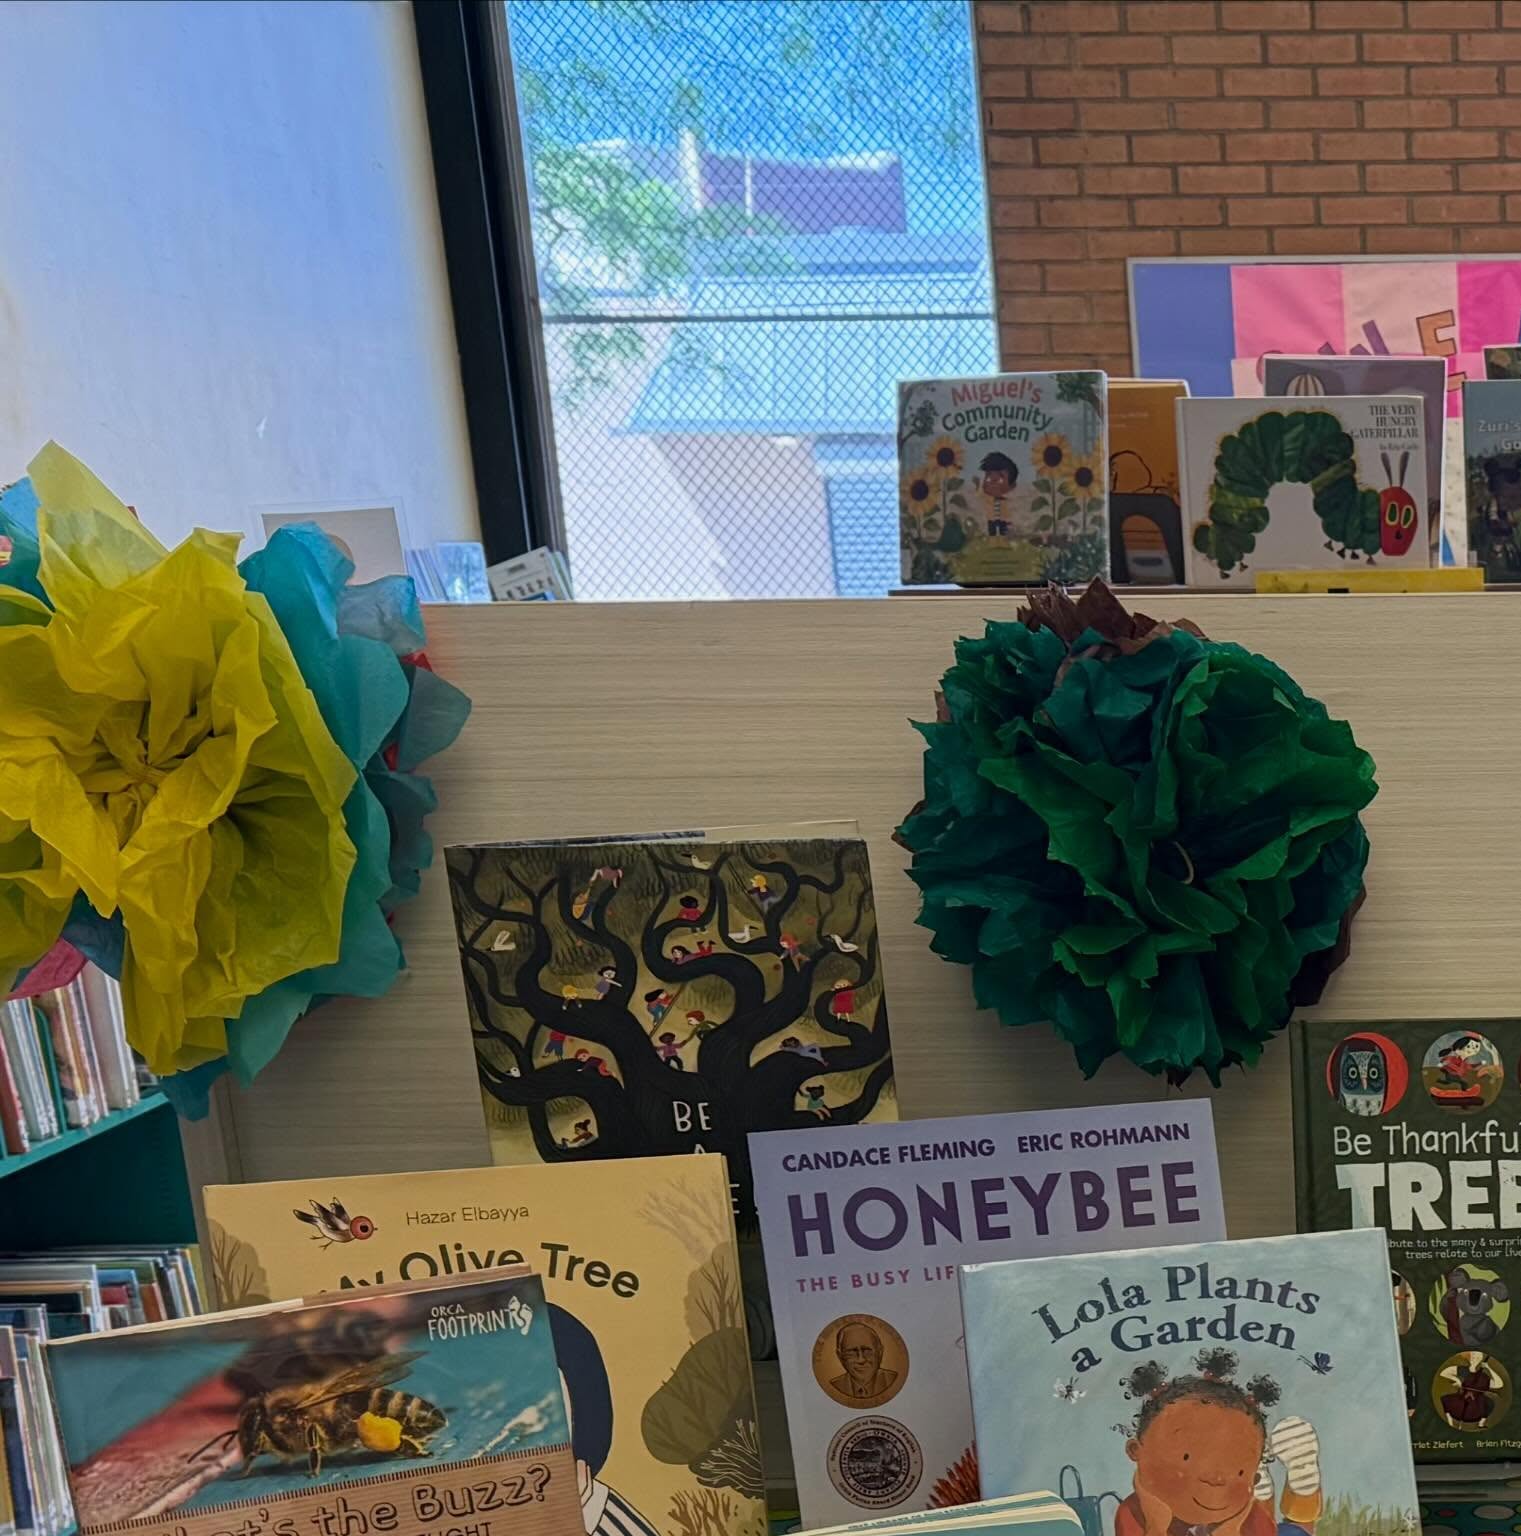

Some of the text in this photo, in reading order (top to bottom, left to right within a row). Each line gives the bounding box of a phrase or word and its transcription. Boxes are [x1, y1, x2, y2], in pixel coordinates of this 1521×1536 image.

[951, 377, 1043, 407] Miguel's
[942, 404, 1054, 432] Community
[1369, 404, 1416, 416] THE VERY
[1375, 415, 1416, 427] HUNGRY
[964, 421, 1030, 443] Garden
[1478, 419, 1521, 433] Zuri's
[672, 1100, 712, 1133] BE
[1017, 1122, 1191, 1154] ERIC ROHMANN
[1333, 1125, 1372, 1156] Be
[782, 1138, 996, 1174] CANDACE FLEMING
[406, 1203, 530, 1227] Hazar Elbayya
[787, 1161, 1201, 1258] HONEYBEE
[1405, 1251, 1433, 1260] trees
[1435, 1249, 1468, 1259] relate
[1471, 1249, 1482, 1258] to
[1485, 1250, 1502, 1258] our
[1417, 1239, 1428, 1248] to
[1431, 1237, 1448, 1248] the
[1451, 1238, 1476, 1250] many
[1479, 1238, 1486, 1247] &
[540, 1241, 641, 1299] Tree
[796, 1264, 955, 1294] THE BUSY LIF
[431, 1303, 465, 1318] ORCA
[1032, 1262, 1321, 1345] Lola Plants
[1071, 1302, 1297, 1374] a Garden
[411, 1462, 552, 1523] Buzz?
